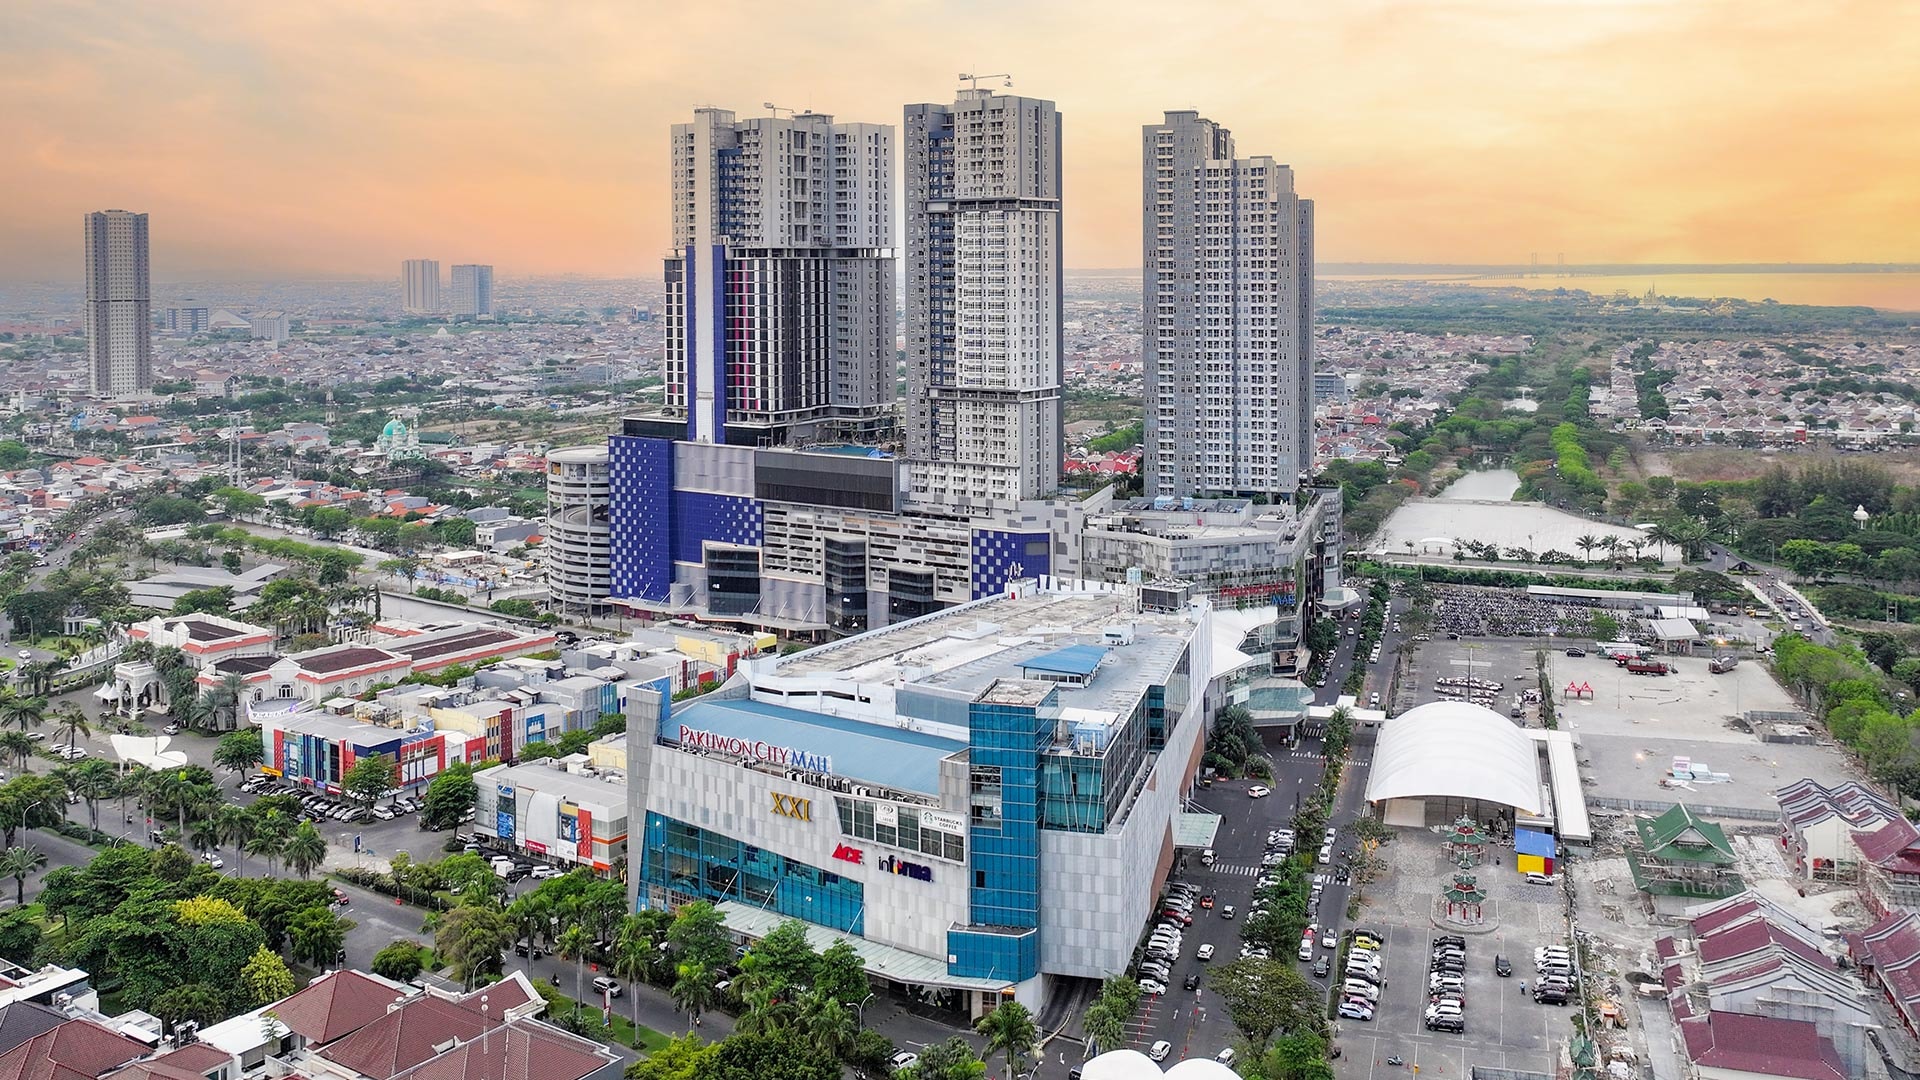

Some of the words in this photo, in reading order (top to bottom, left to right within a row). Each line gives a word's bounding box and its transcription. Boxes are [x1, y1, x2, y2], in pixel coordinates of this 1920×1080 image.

[679, 725, 752, 755] PAKUWON
[755, 741, 788, 764] CITY
[791, 750, 828, 773] MALL
[770, 791, 811, 822] XXI
[934, 816, 963, 826] STARBUCKS
[938, 822, 958, 830] COFFEE
[832, 842, 864, 864] ACE
[878, 855, 933, 882] informa
